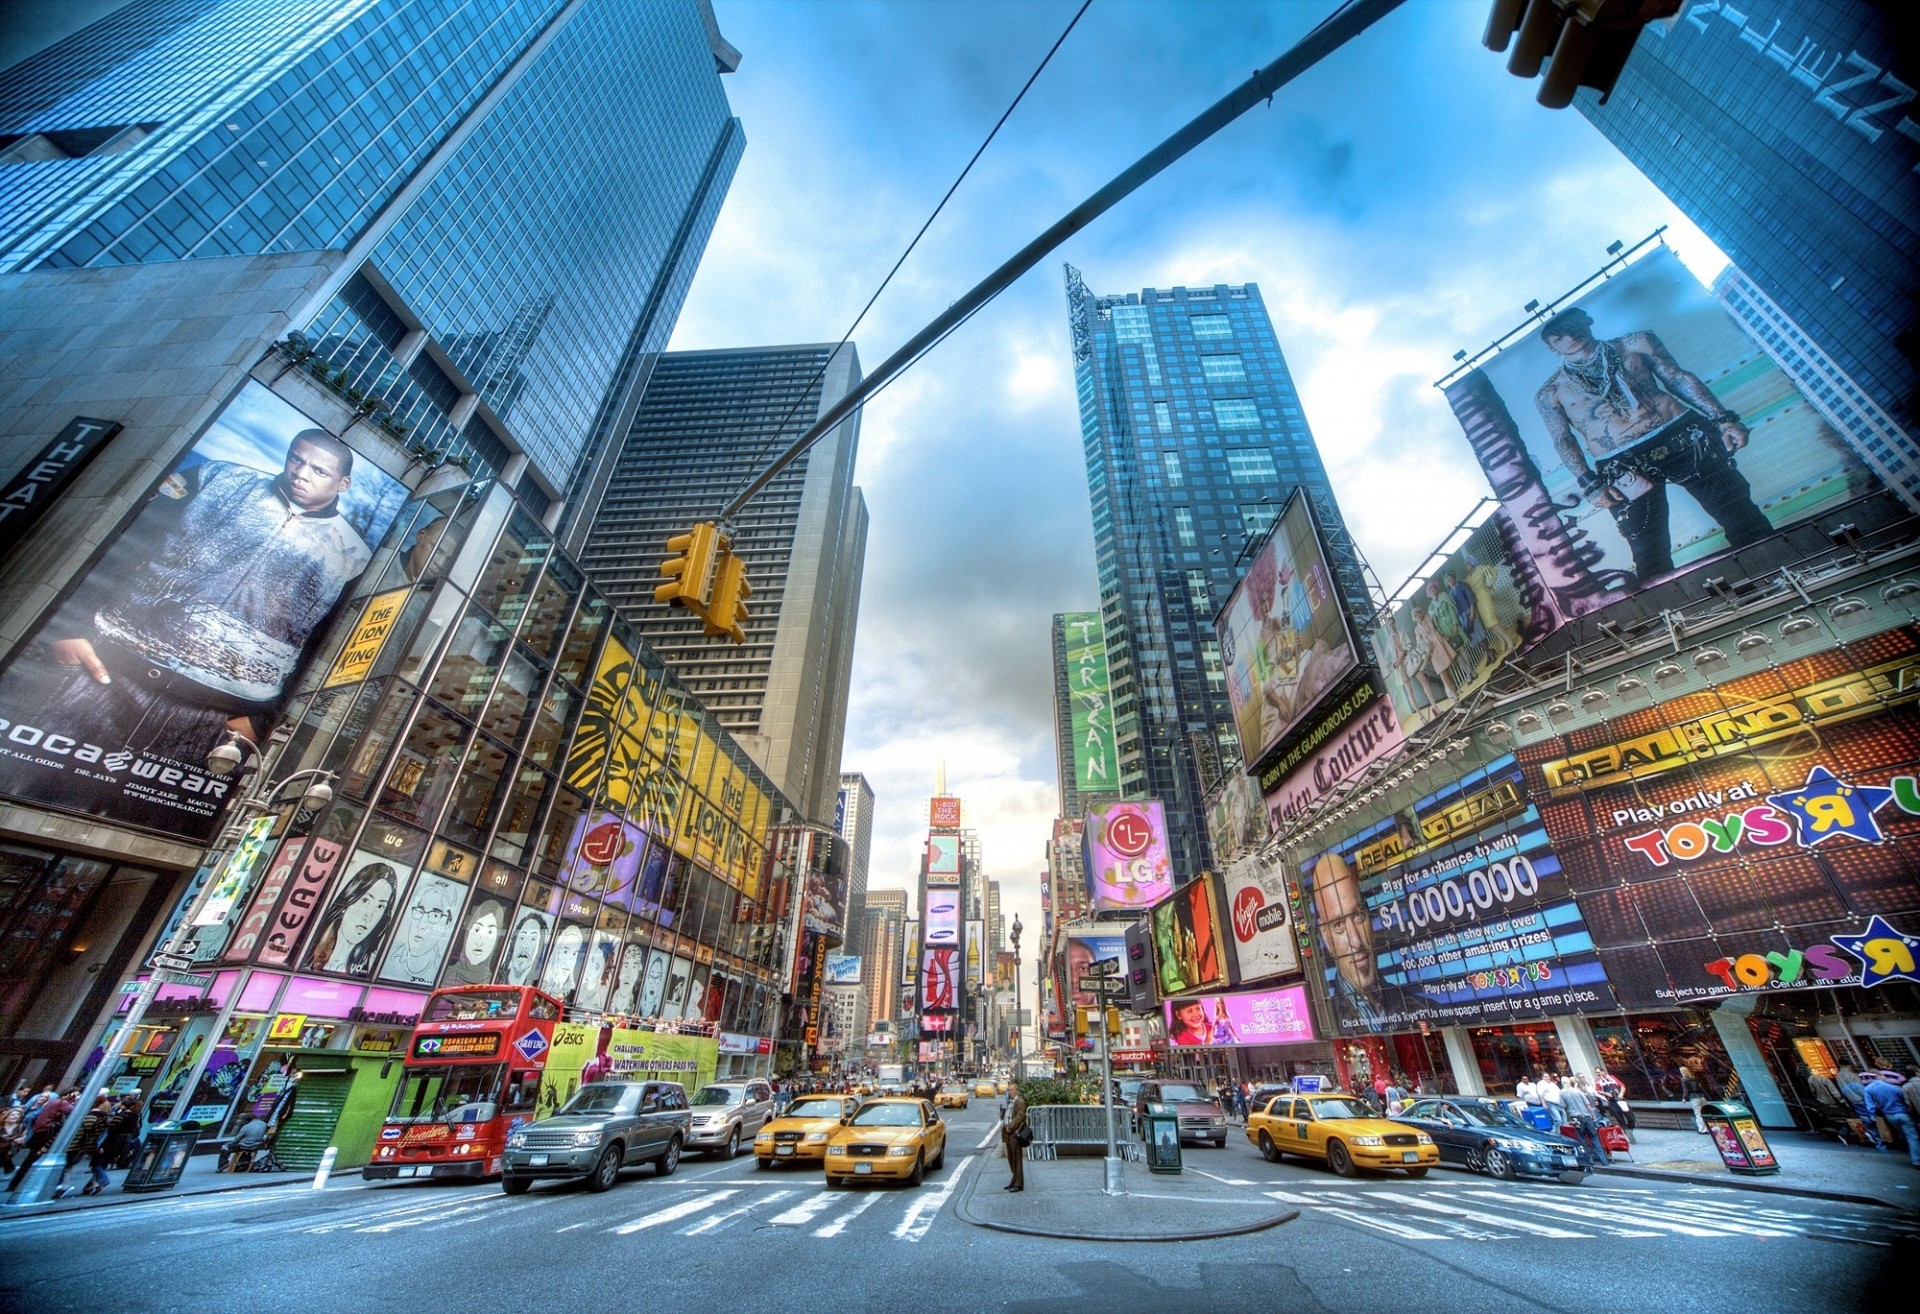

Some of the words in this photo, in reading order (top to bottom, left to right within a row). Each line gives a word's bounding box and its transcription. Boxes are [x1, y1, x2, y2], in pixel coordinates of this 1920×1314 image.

[369, 607, 393, 623] THE
[350, 624, 388, 649] LION
[335, 647, 375, 675] KING
[1069, 620, 1113, 779] TARZAN
[1261, 768, 1281, 790] BORN
[1279, 762, 1289, 774] IN
[1287, 750, 1303, 769] THE
[1301, 701, 1353, 755] GLAMOROUS
[1352, 683, 1375, 709] USA
[11, 752, 35, 764] ALL
[35, 757, 65, 770] ODDS
[142, 751, 158, 761] WE
[161, 756, 182, 768] RUN
[183, 762, 205, 773] THE
[74, 767, 92, 779] DR.
[93, 772, 118, 784] JAYS
[123, 788, 214, 817] WWW.ROCAWEAR.COM
[126, 782, 156, 796] JIMMY
[157, 790, 180, 801] JAZZ
[1613, 803, 1665, 828] Play
[1670, 789, 1723, 817] only
[1727, 778, 1758, 801] at
[186, 797, 218, 811] MACY'S
[384, 833, 403, 848] we
[1625, 805, 1792, 867] TOYS
[1114, 860, 1153, 884] LG
[1382, 878, 1402, 893] Play
[1404, 871, 1420, 885] for
[1422, 869, 1430, 879] a
[1431, 853, 1474, 875] chance
[1492, 833, 1520, 852] win
[495, 874, 508, 886] all
[269, 845, 336, 954] PEACE
[1379, 854, 1538, 937] $1,000,000
[569, 903, 590, 914] speak
[1235, 893, 1259, 936] Virgin
[1258, 906, 1284, 929] mobile
[1399, 943, 1410, 956] or
[1417, 935, 1434, 955] trip
[1434, 933, 1445, 948] to
[1446, 928, 1462, 944] the
[1464, 923, 1495, 942] show,
[1496, 921, 1508, 934] or
[1511, 914, 1537, 930] over
[157, 956, 170, 965] ONE
[174, 960, 188, 968] WAY
[814, 935, 826, 979] KODAK
[1400, 955, 1436, 973] 100,000
[1438, 949, 1462, 966] other
[1464, 939, 1510, 959] amazing
[1510, 930, 1552, 953] prizes!
[1424, 983, 1440, 996] Play
[1440, 979, 1458, 992] only
[1458, 978, 1467, 990] at
[1467, 970, 1507, 991] TOYS
[1526, 961, 1552, 982] US
[1704, 944, 1852, 989] TOYS
[1084, 981, 1097, 989] ONE
[1655, 986, 1694, 999] Subject
[1694, 985, 1707, 996] to
[809, 983, 821, 1025] digital
[1439, 1004, 1480, 1019] newspaper
[1482, 1000, 1507, 1013] insert
[1509, 996, 1523, 1010] for
[1524, 999, 1532, 1009] a
[1532, 993, 1567, 1011] game
[1565, 989, 1600, 1006] piece.
[480, 1036, 497, 1044] LOOP
[519, 1039, 533, 1049] GRAY
[533, 1039, 546, 1049] LINE
[614, 1059, 649, 1071] WATCHING
[650, 1060, 673, 1070] OTHERS
[673, 1060, 687, 1070] PASS
[687, 1060, 698, 1070] YOU
[1120, 1052, 1146, 1060] swatch
[397, 1125, 451, 1148] Broadway
